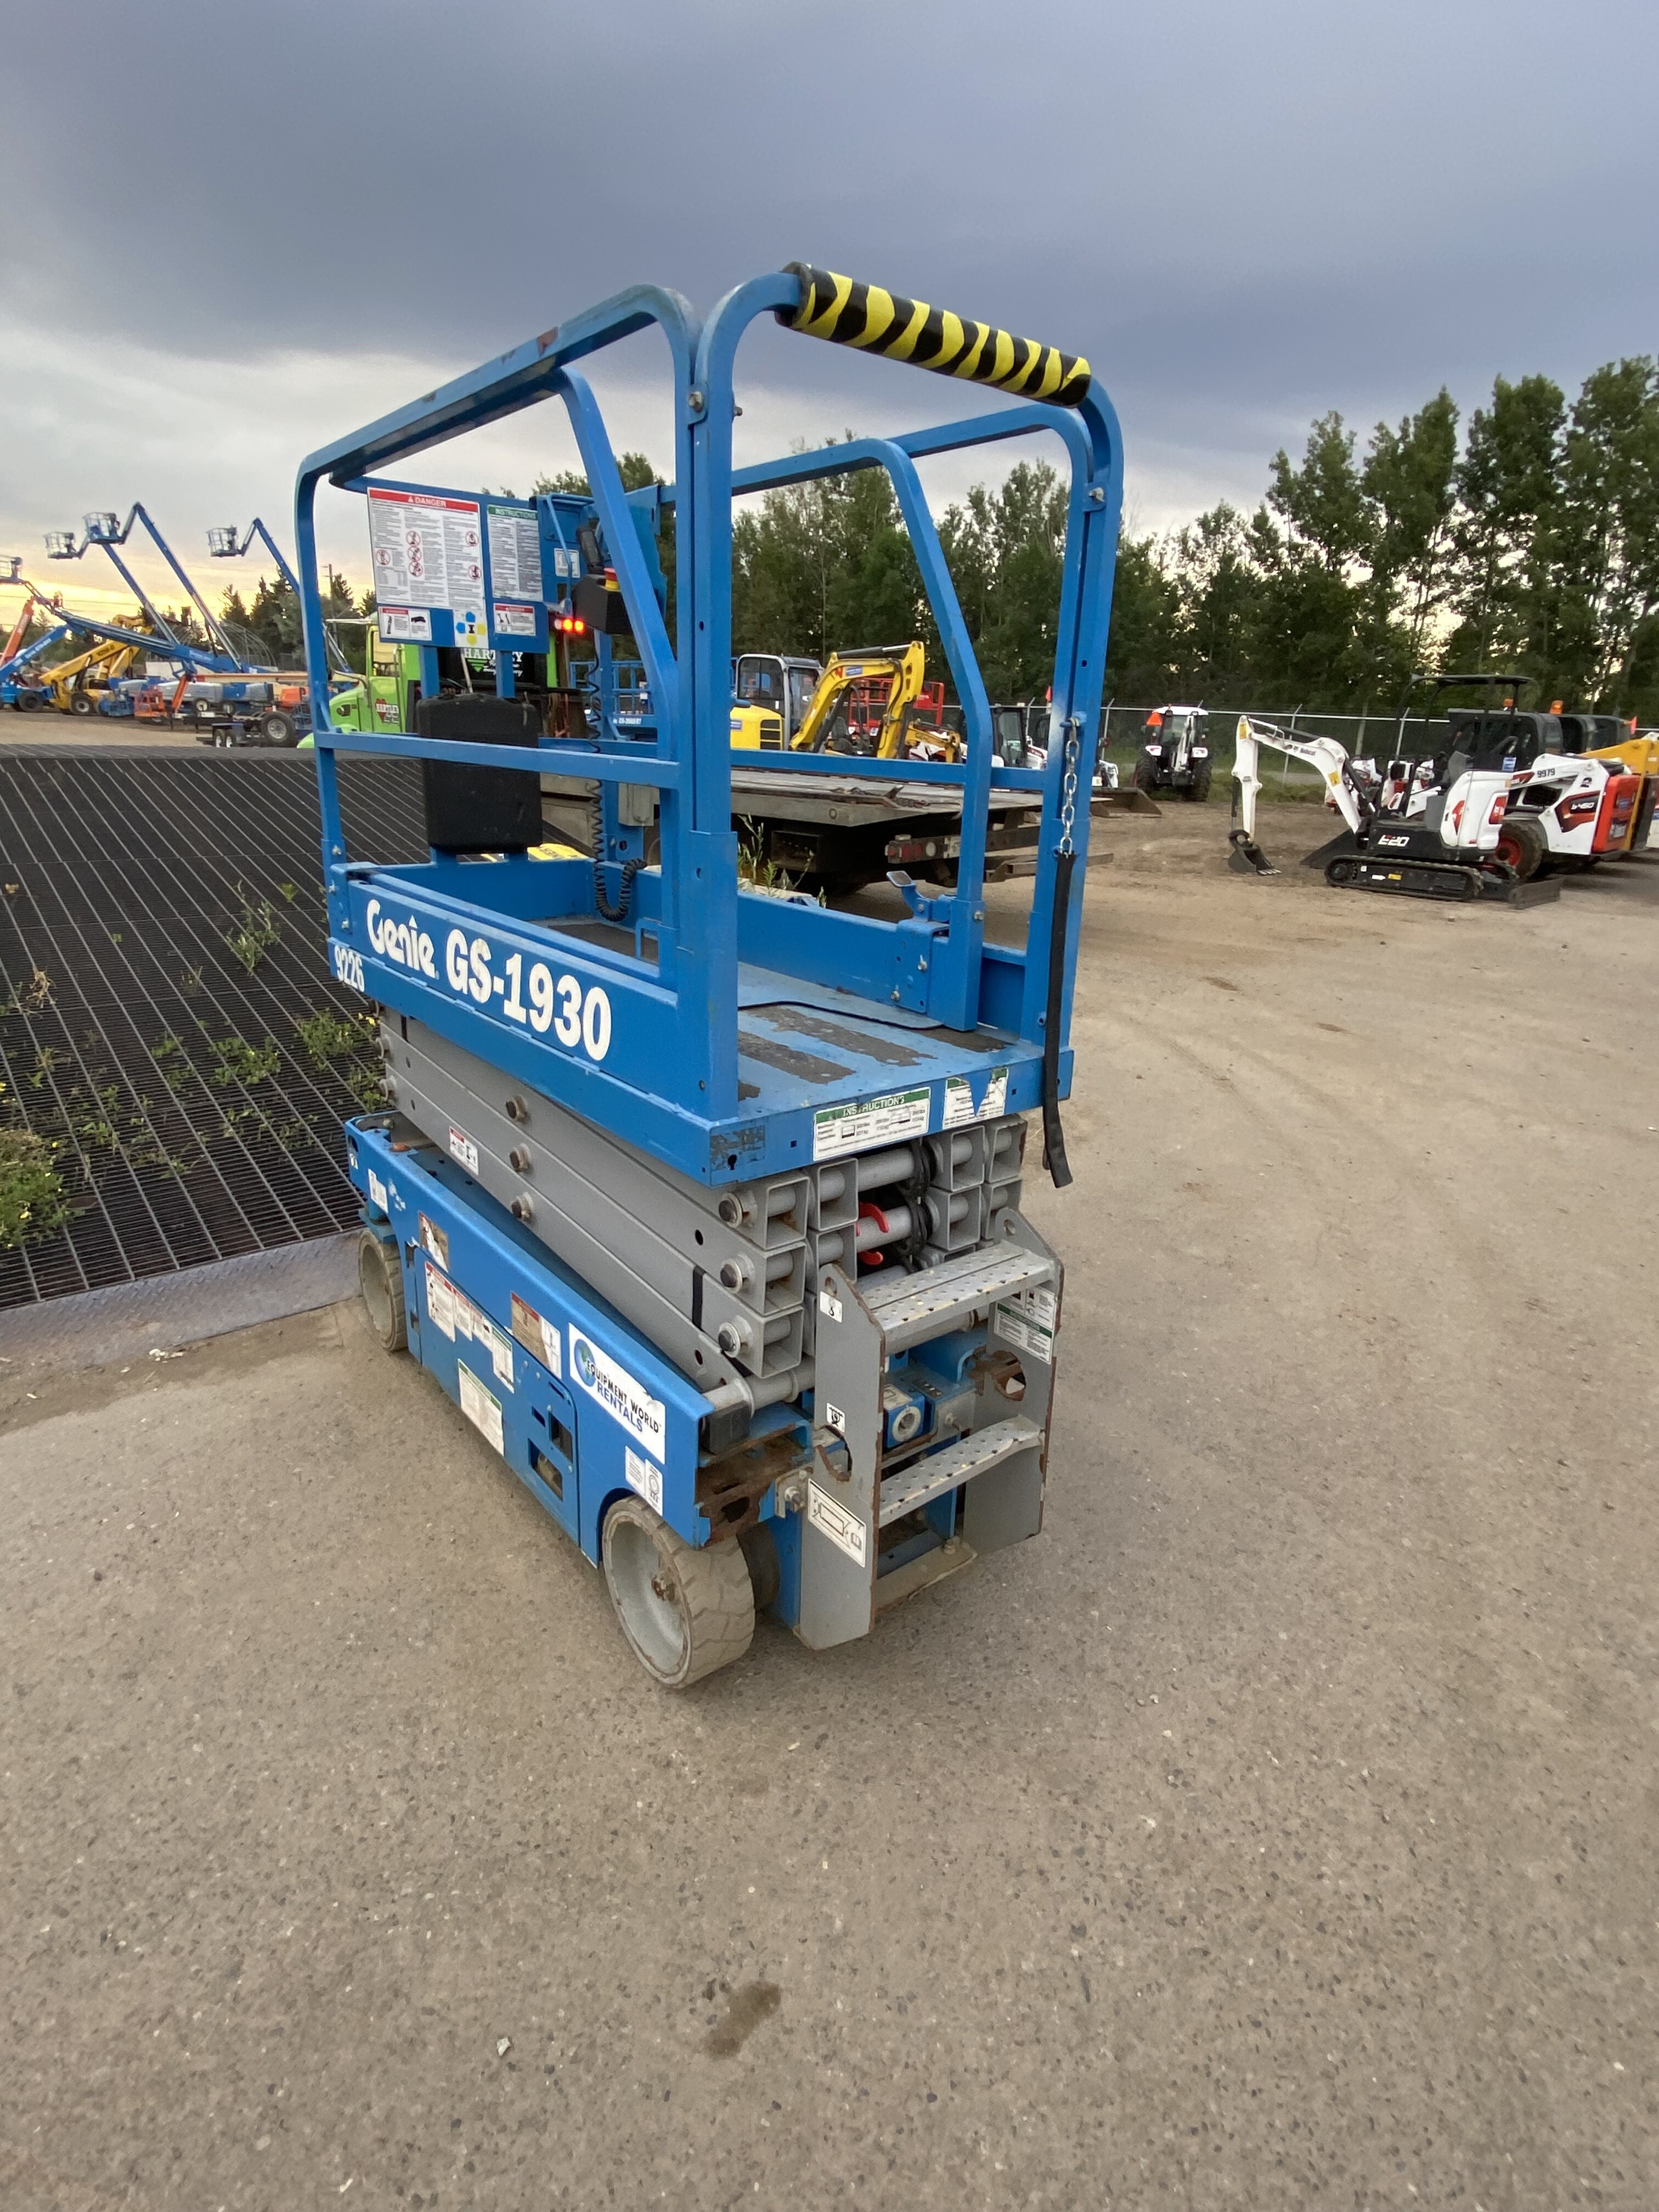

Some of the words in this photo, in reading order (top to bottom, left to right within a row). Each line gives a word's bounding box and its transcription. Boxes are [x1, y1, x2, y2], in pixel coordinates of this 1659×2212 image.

[415, 496, 447, 507] DANGER
[495, 508, 537, 520] INSTRUCTIONS
[1537, 768, 1555, 778] 9979
[1378, 834, 1410, 847] E20
[334, 945, 365, 992] 9226
[367, 899, 437, 979] Genie
[446, 928, 612, 1061] GS-1930
[842, 1095, 905, 1118] INSRUCTIONS
[587, 1360, 627, 1404] EQUIPMENT
[631, 1399, 659, 1433] WORLD
[597, 1380, 643, 1432] RENTALS
